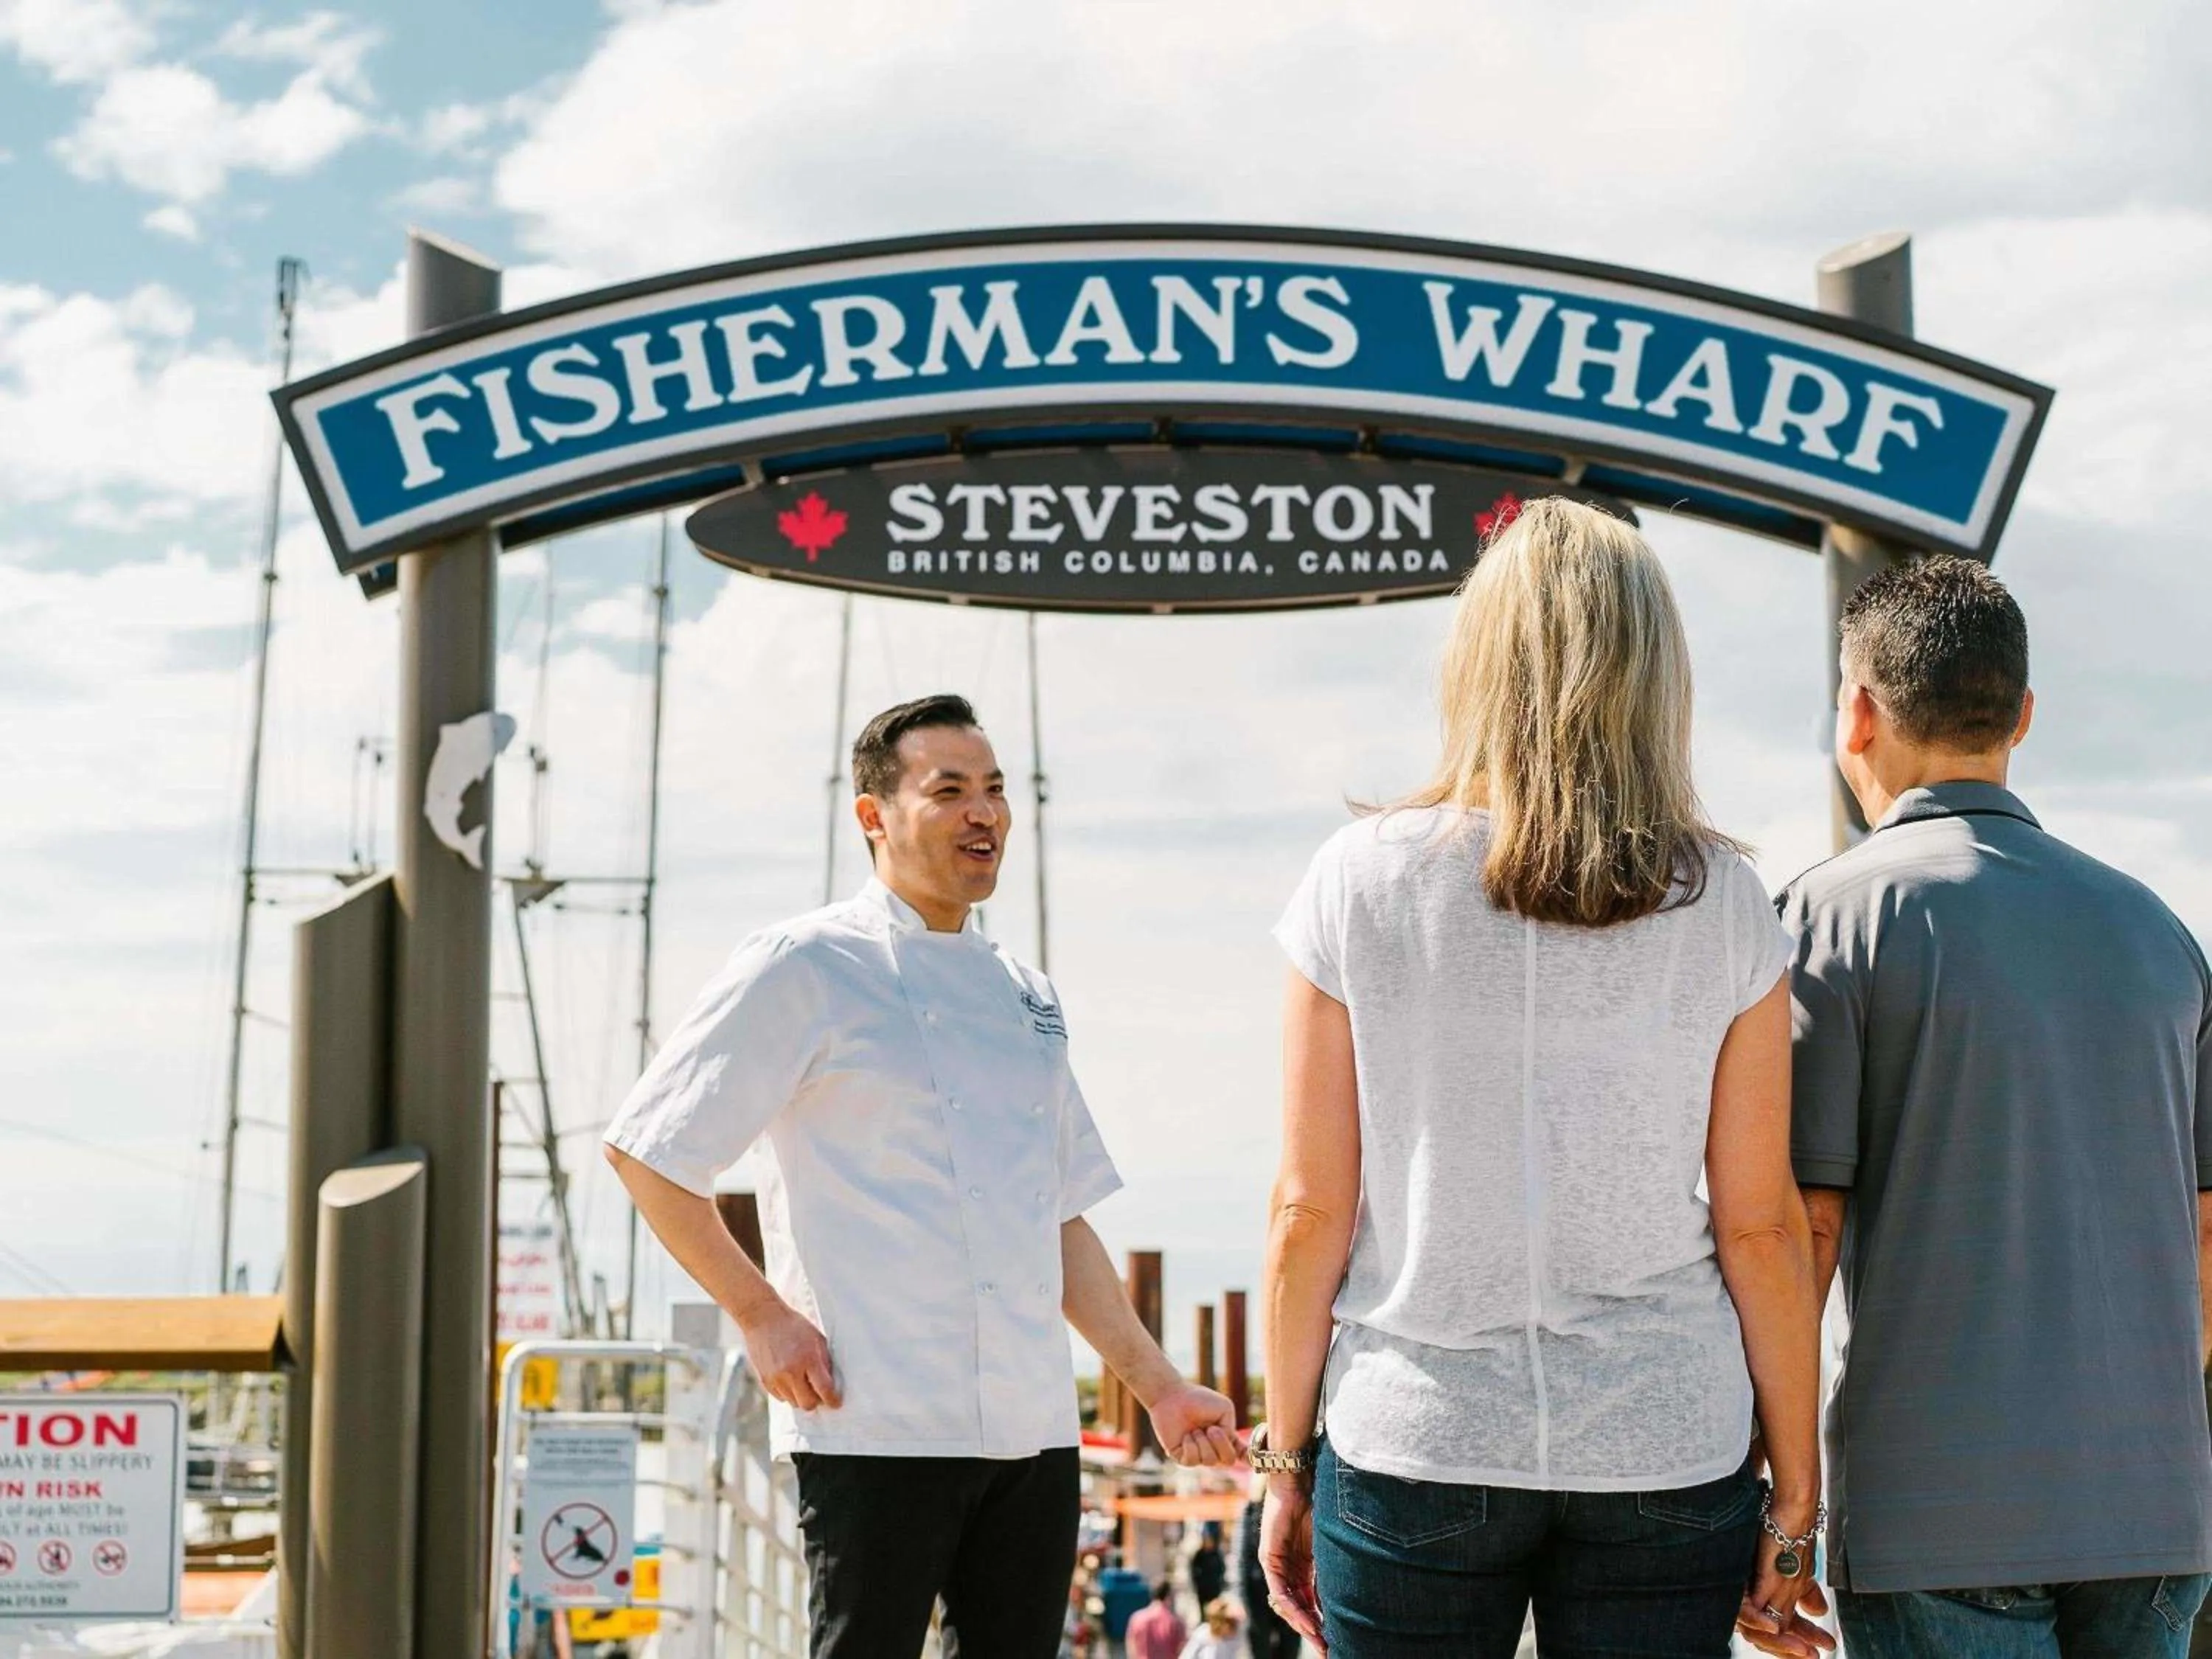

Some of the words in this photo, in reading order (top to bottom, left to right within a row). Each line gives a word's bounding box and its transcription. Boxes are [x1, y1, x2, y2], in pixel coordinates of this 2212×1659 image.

[375, 275, 1360, 490] FISHERMAN'S
[1422, 280, 1944, 474] WHARF
[886, 483, 1435, 543] STEVESTON
[887, 549, 1040, 573] BRITISH
[1298, 549, 1449, 573] CANADA
[42, 1453, 61, 1470] BE
[71, 1453, 153, 1472] SLIPPERY
[37, 1480, 102, 1498] RISK
[45, 1522, 71, 1537] ALL
